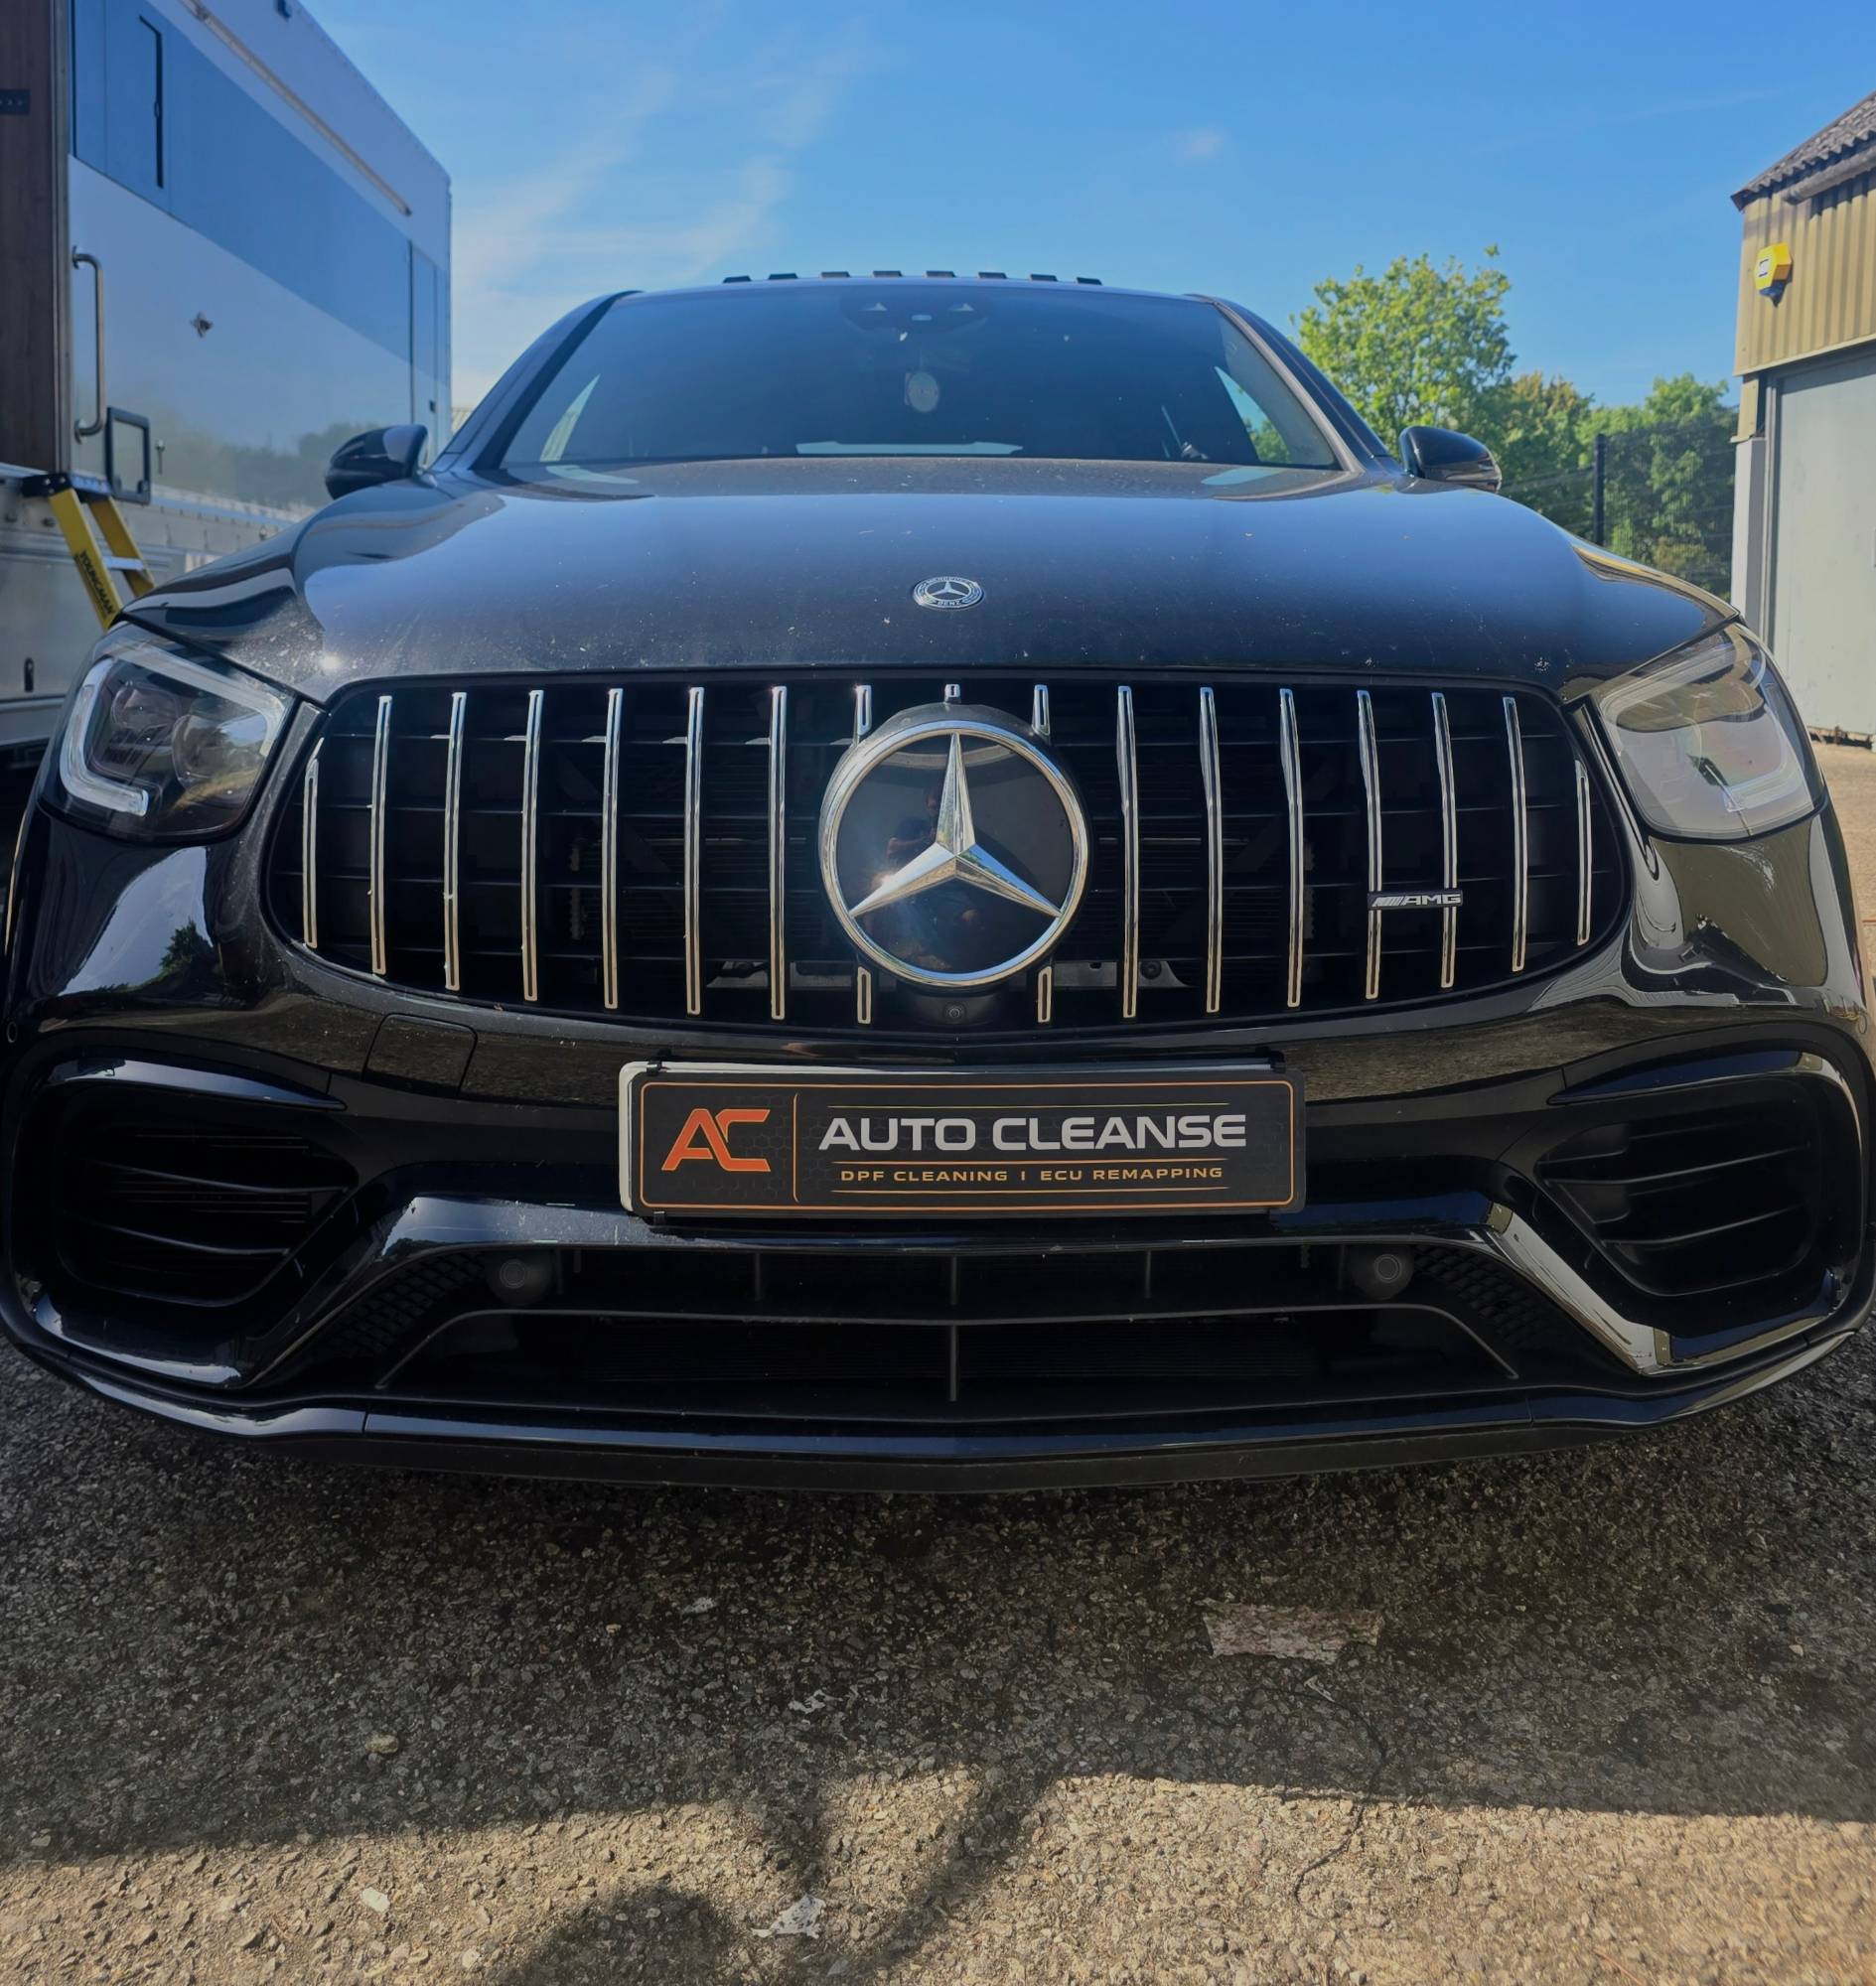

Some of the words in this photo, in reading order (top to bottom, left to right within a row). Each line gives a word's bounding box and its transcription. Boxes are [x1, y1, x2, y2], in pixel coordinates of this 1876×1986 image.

[660, 1107, 772, 1172] AC
[817, 1117, 976, 1152] AUTO
[992, 1114, 1246, 1152] CLEANSE
[840, 1170, 885, 1182] DPF
[893, 1170, 1008, 1182] CLEANING
[1040, 1169, 1082, 1182] ECU
[1092, 1166, 1223, 1181] REMAPPING
